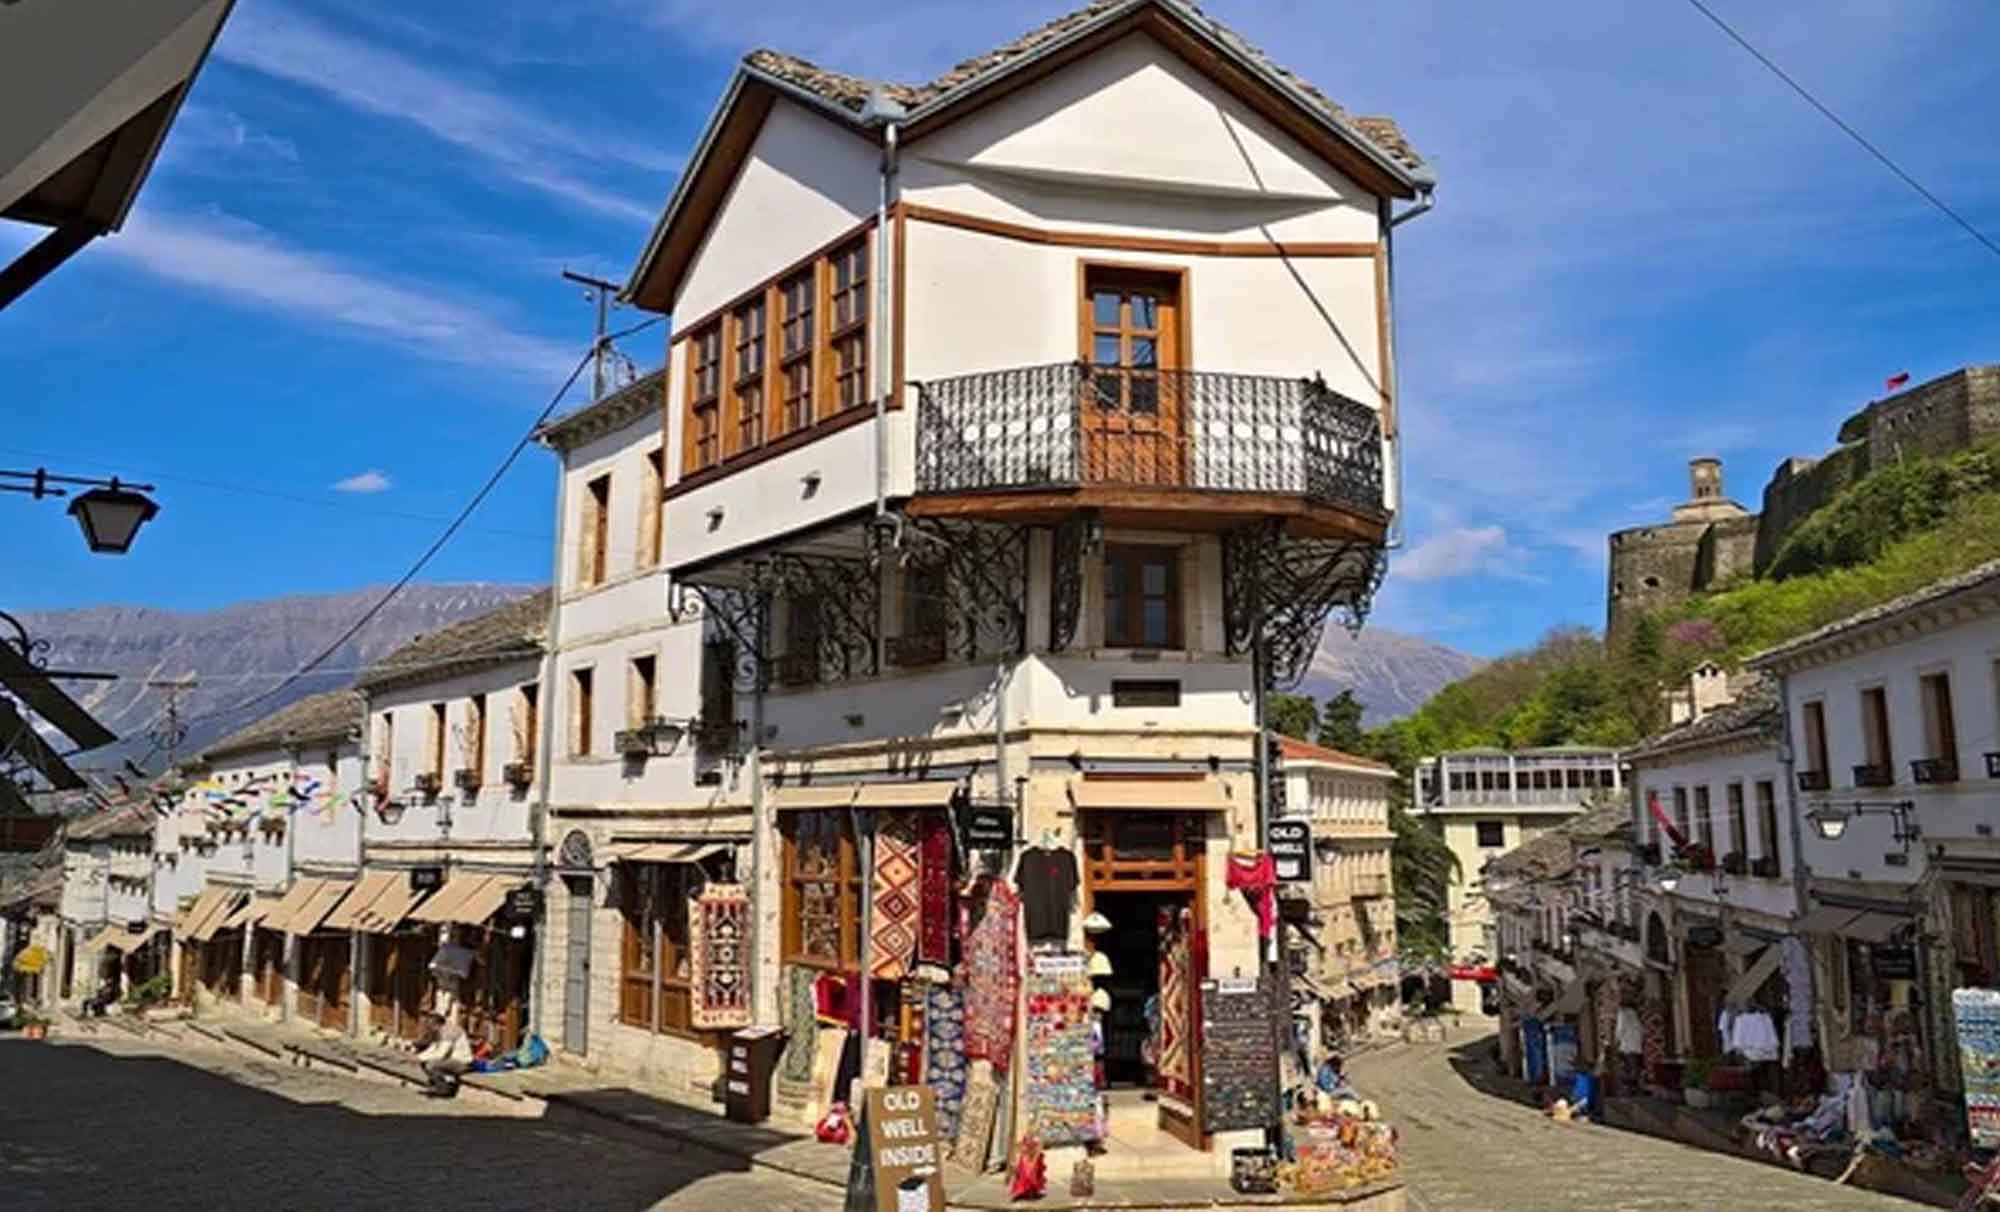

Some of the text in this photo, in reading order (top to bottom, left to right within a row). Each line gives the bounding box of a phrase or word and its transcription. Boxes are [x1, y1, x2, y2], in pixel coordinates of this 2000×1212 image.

[1270, 827, 1304, 839] OLD
[1271, 842, 1304, 854] WELL
[883, 1091, 920, 1112] OLD
[880, 1118, 928, 1138] WELL
[881, 1143, 936, 1167] INSIDE
